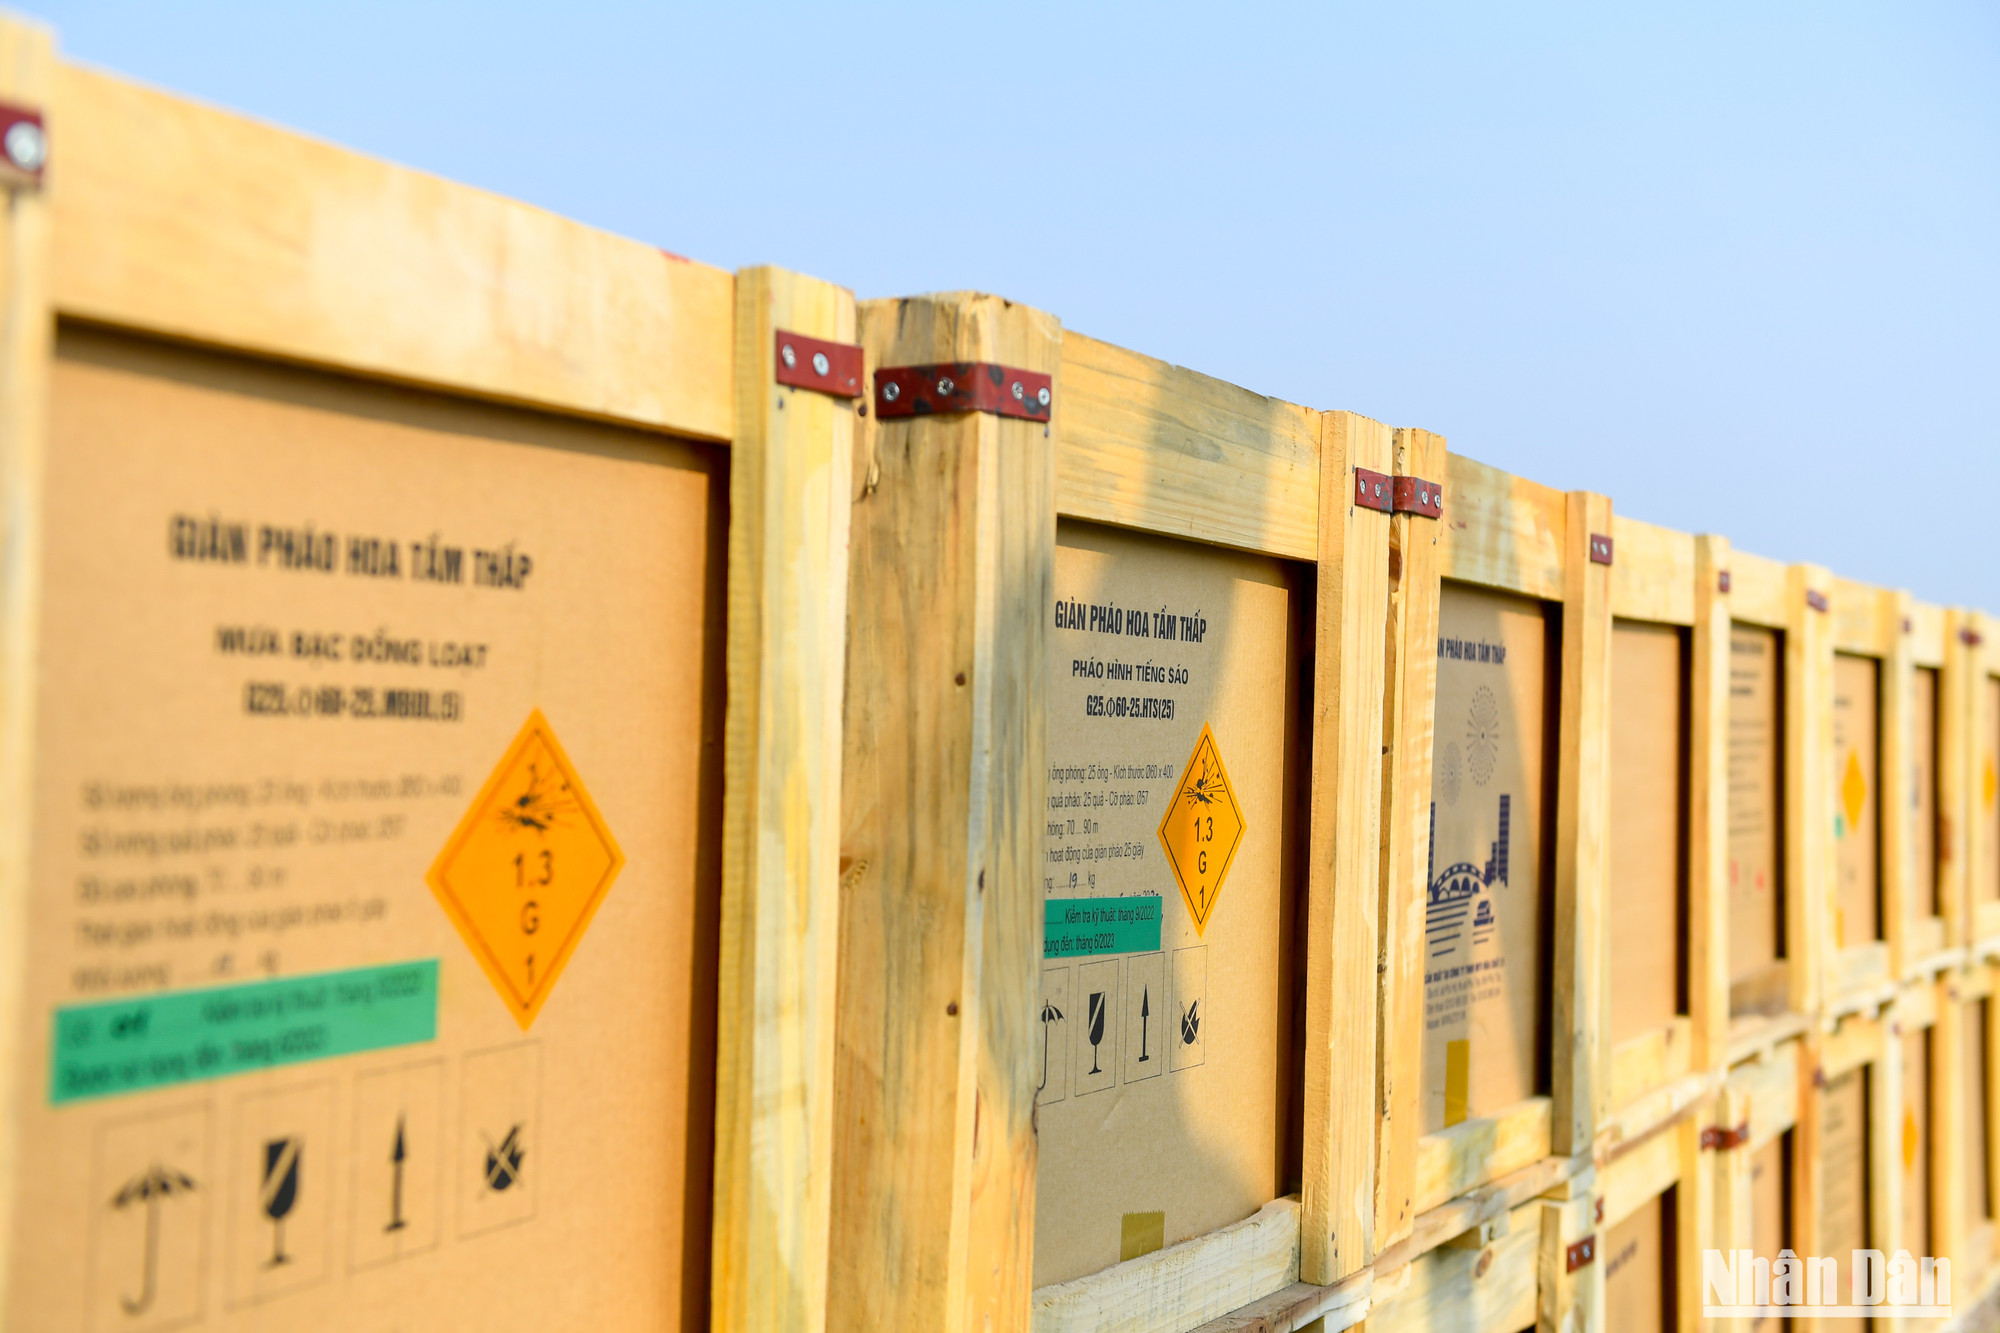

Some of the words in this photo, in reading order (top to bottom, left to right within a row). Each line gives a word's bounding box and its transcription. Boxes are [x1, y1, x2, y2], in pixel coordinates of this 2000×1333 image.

[257, 520, 338, 574] PHÁO
[345, 534, 401, 582] HOA
[1055, 597, 1086, 630] GIÀN
[1090, 602, 1123, 635] PHÁO
[1126, 609, 1149, 638] HOA
[1153, 605, 1176, 640] TẦM
[1180, 609, 1207, 643] THẤP
[1072, 657, 1104, 679] PHÁO
[1106, 659, 1133, 681] HÌNH
[1136, 659, 1165, 684] TIẾNG
[1168, 664, 1189, 684] SÁO
[1088, 764, 1096, 780] 25
[1097, 761, 1109, 783] ống
[1114, 764, 1126, 779] Kích
[1163, 764, 1173, 779] 400
[1083, 791, 1091, 807] 25
[1047, 821, 1065, 840] hóng:
[1067, 819, 1075, 835] 70
[1083, 818, 1091, 834] 90
[1093, 822, 1099, 834] m
[1194, 817, 1213, 842] 1.3
[1082, 844, 1093, 860] của
[1124, 842, 1131, 857] 25
[1198, 851, 1207, 874] G
[512, 849, 553, 888] 1.3
[1088, 870, 1095, 889] kg
[1199, 885, 1205, 909] 1
[521, 901, 539, 934] G
[1082, 909, 1091, 923] tra
[526, 954, 534, 985] 1
